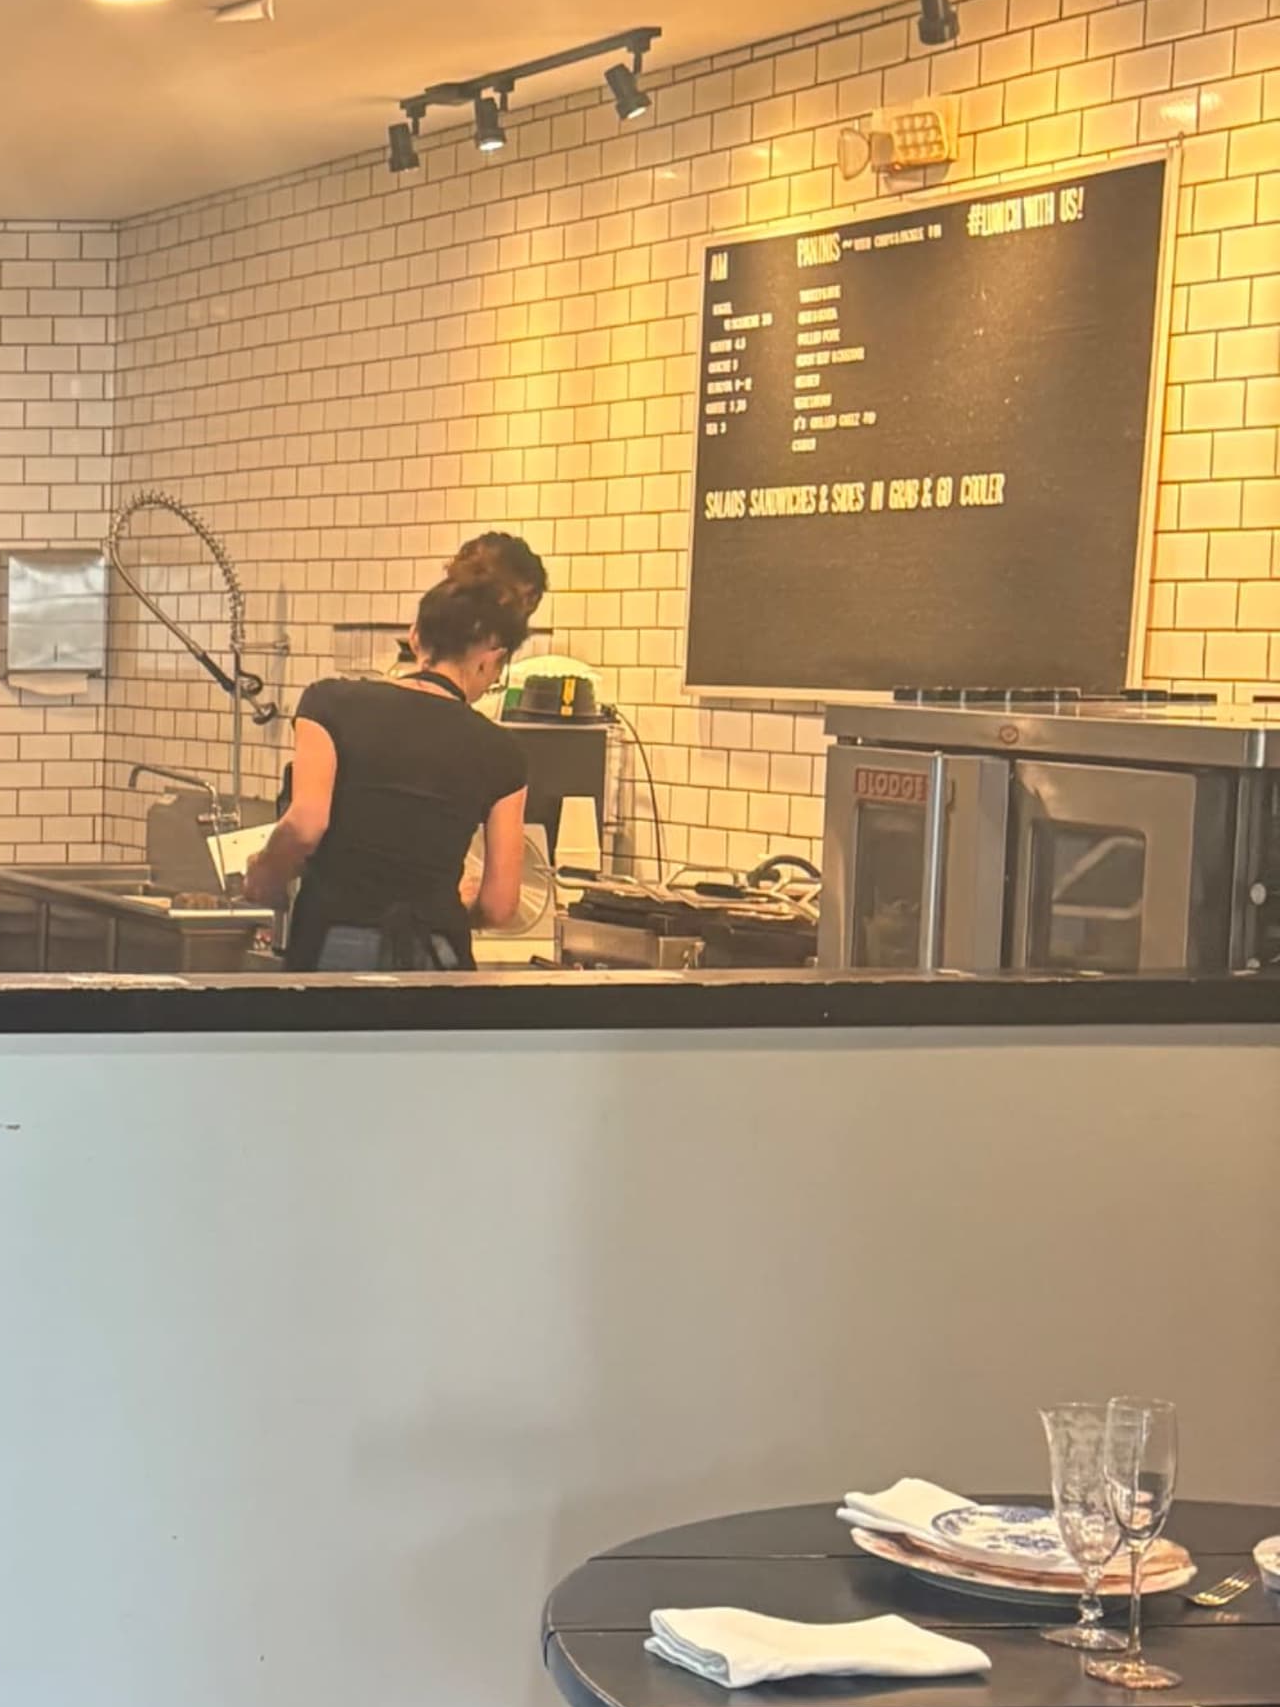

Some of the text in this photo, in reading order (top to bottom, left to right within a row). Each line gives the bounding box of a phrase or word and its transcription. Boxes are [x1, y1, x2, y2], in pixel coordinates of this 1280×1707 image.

[1023, 191, 1055, 229] WITH
[1060, 186, 1084, 223] US!
[797, 232, 841, 268] PANINIS
[704, 490, 746, 520] SALADS
[749, 484, 817, 517] SANDWICHES
[831, 481, 866, 513] SIDES
[889, 478, 920, 510] GRAB
[960, 473, 1005, 506] COOLER
